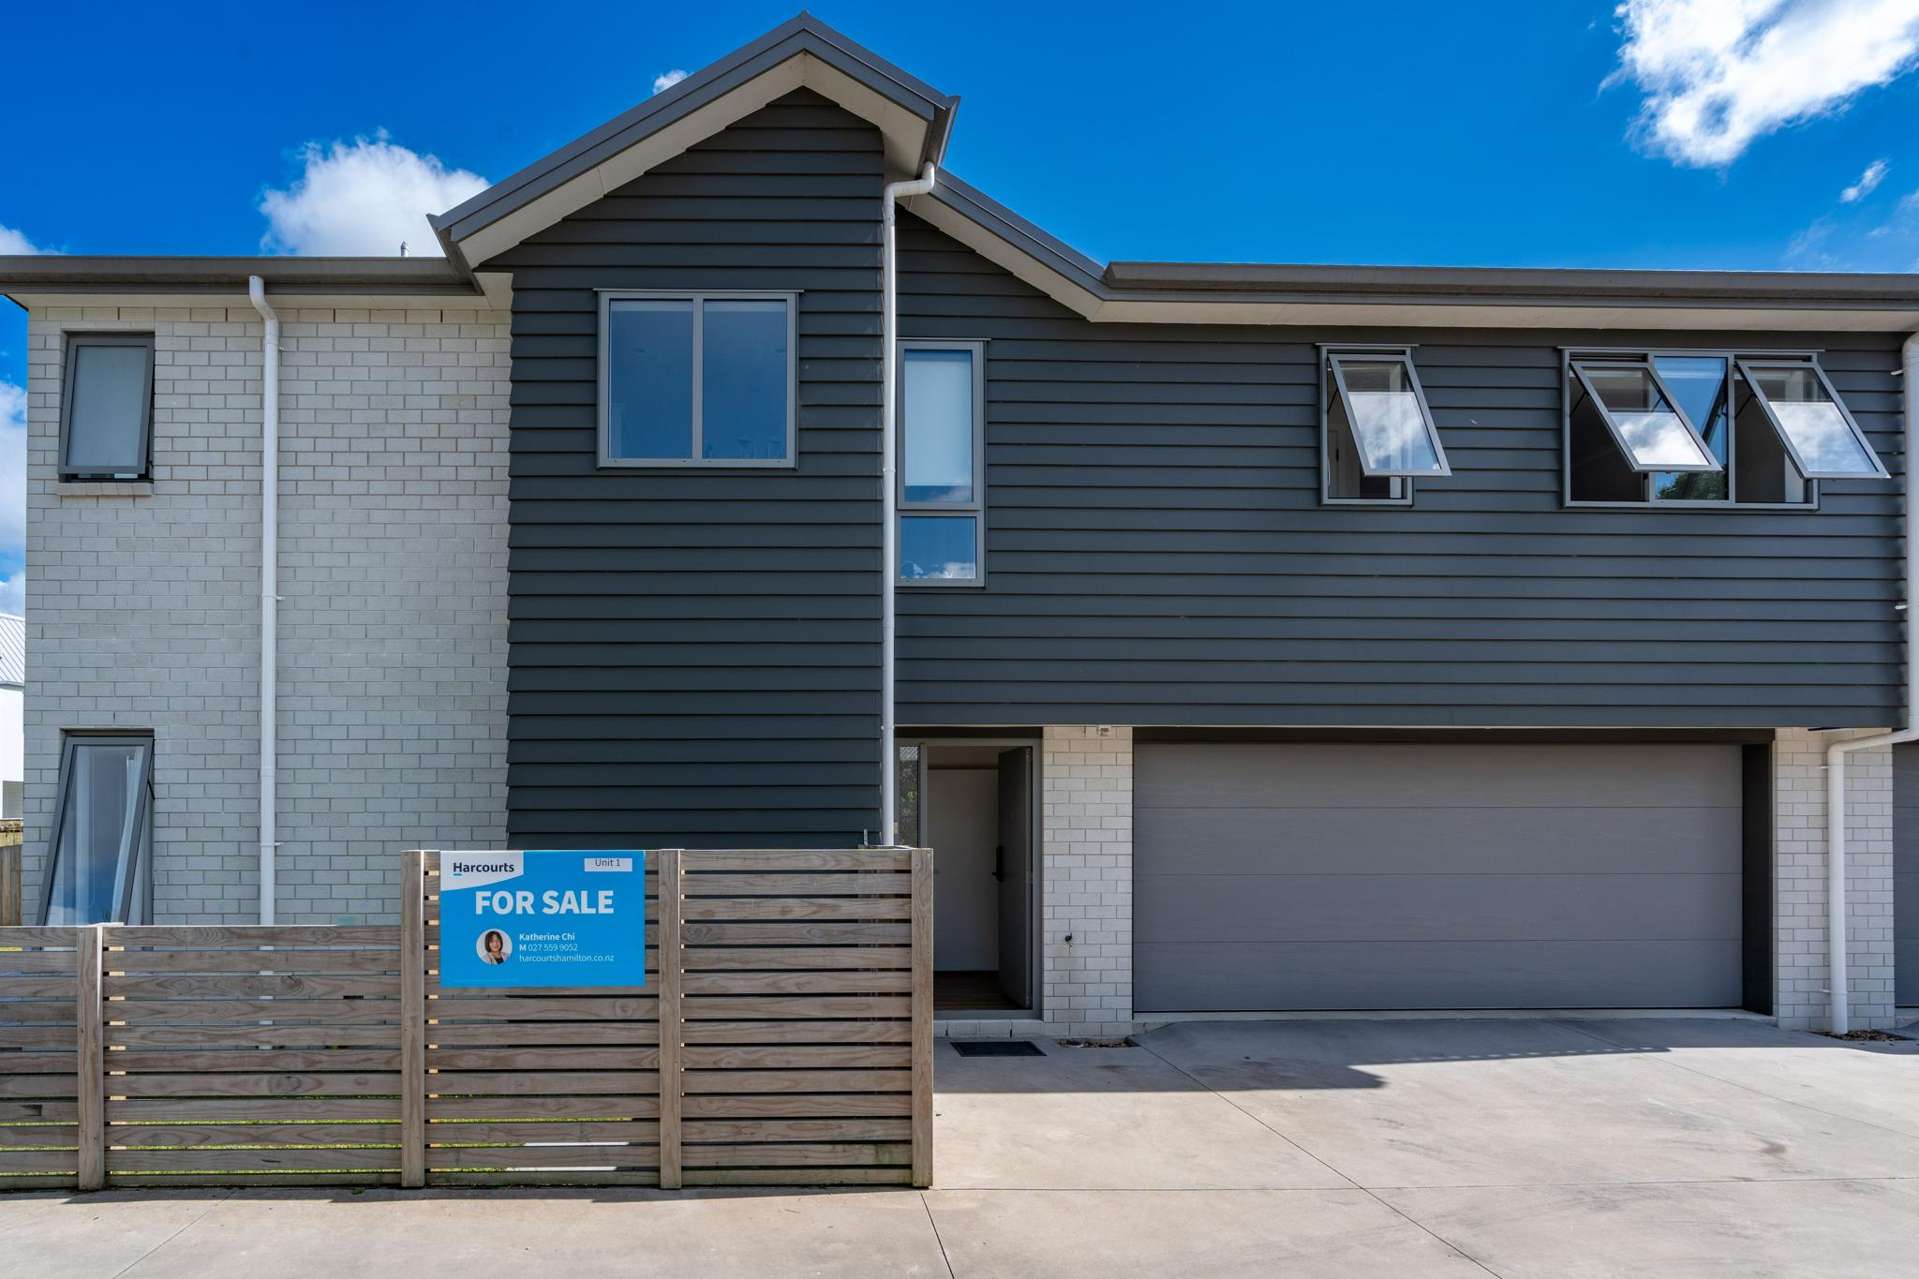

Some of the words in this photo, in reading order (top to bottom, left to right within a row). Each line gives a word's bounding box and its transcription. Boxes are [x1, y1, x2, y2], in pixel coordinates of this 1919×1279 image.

[595, 858, 613, 867] Unit
[615, 859, 621, 867] 1
[453, 862, 514, 873] Harcourts
[475, 890, 535, 915] FOR
[542, 890, 615, 915] SALE
[519, 932, 560, 941] Katherine
[561, 932, 575, 941] Chi
[519, 943, 526, 952] M
[528, 943, 541, 952] 027
[519, 954, 615, 962] harcourtshamilton.co.nz
